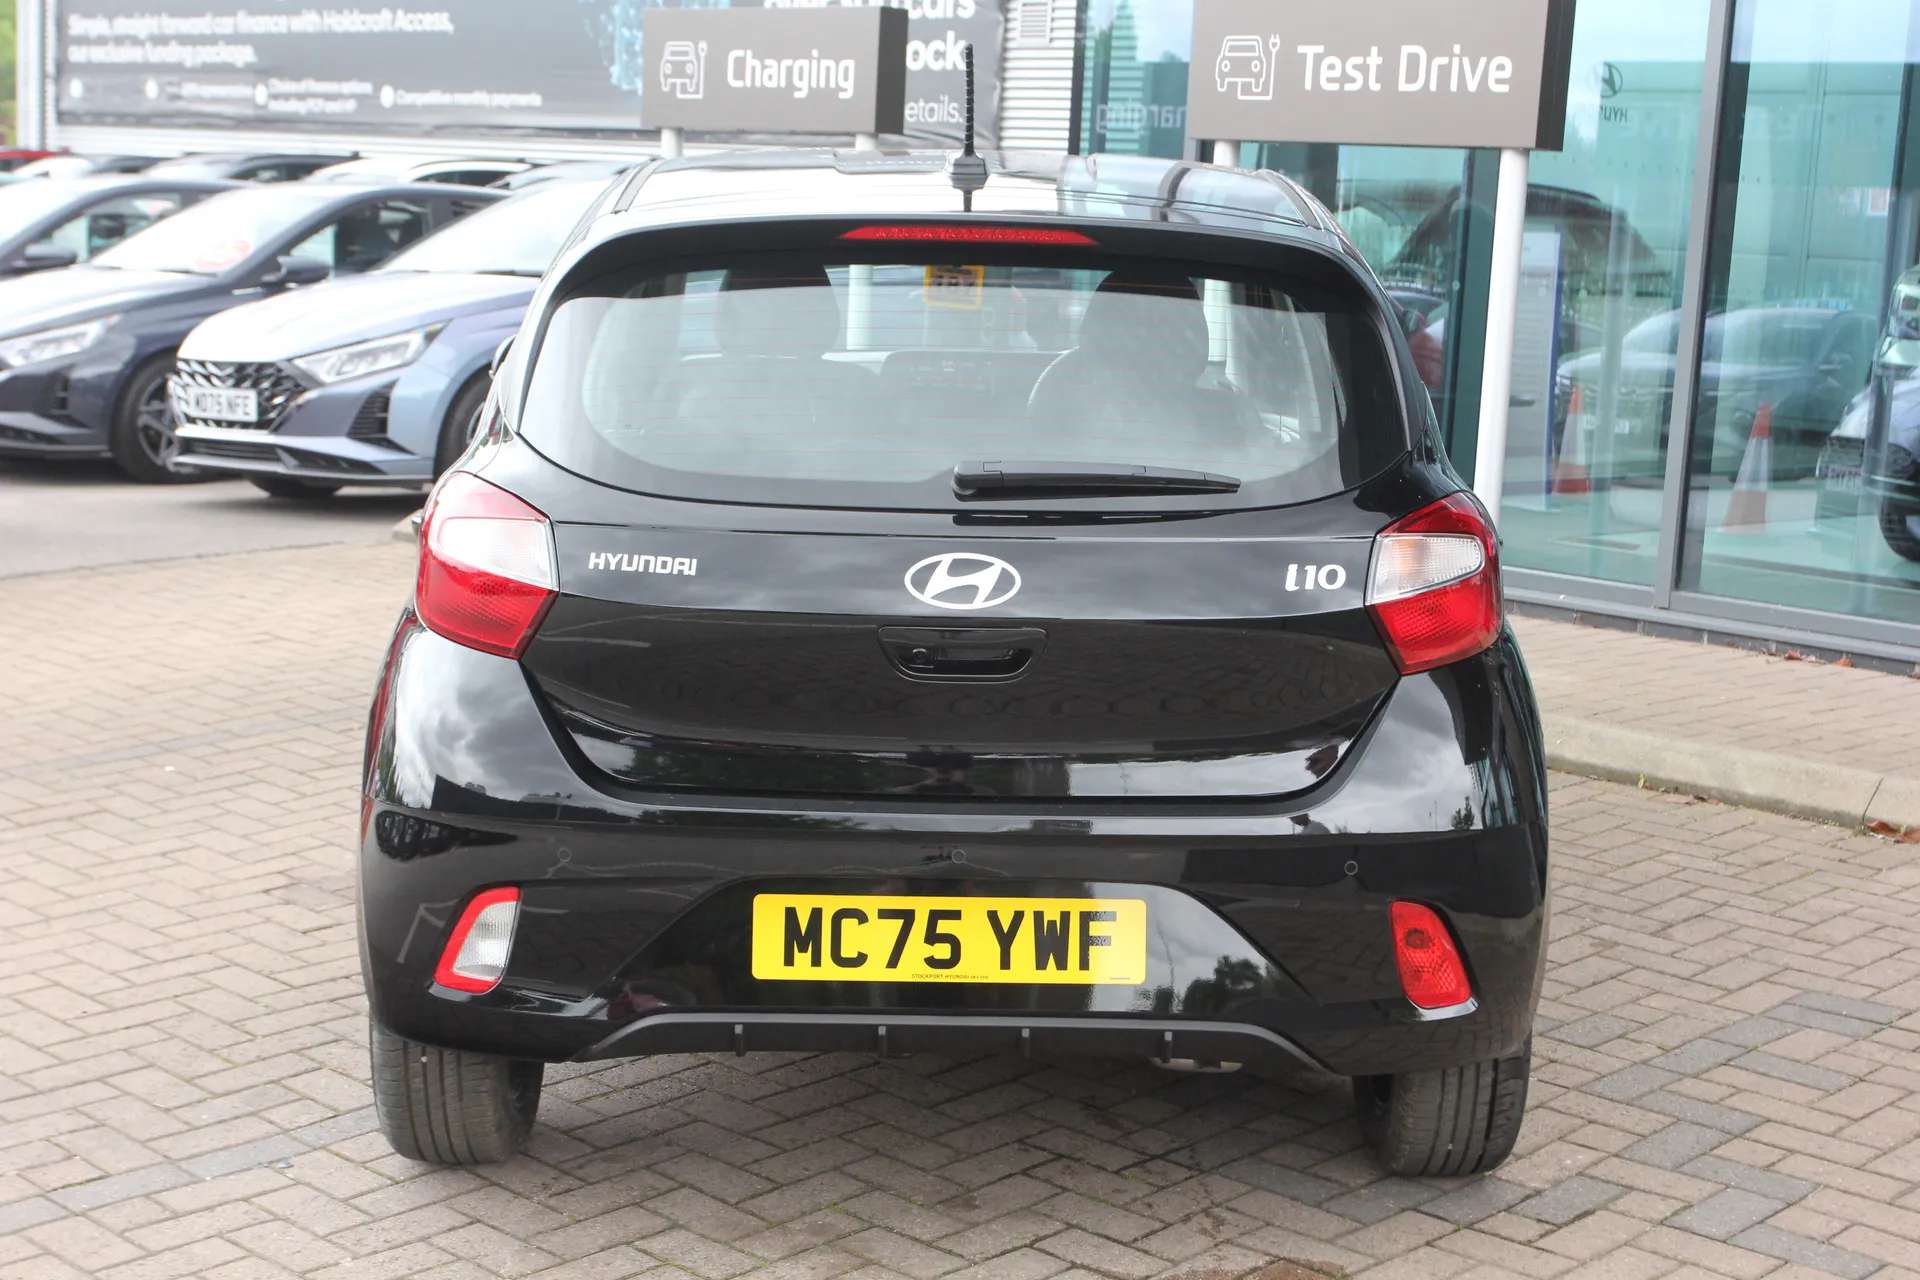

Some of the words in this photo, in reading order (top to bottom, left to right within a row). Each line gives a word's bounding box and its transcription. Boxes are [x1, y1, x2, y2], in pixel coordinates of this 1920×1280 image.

[906, 30, 968, 71] ock
[1297, 44, 1383, 91] Test
[1398, 43, 1513, 93] Drive
[726, 48, 856, 99] Charging
[905, 95, 963, 123] etails.
[588, 551, 698, 577] HYUNDAI
[783, 906, 963, 970] MC75
[986, 909, 1118, 972] YWF
